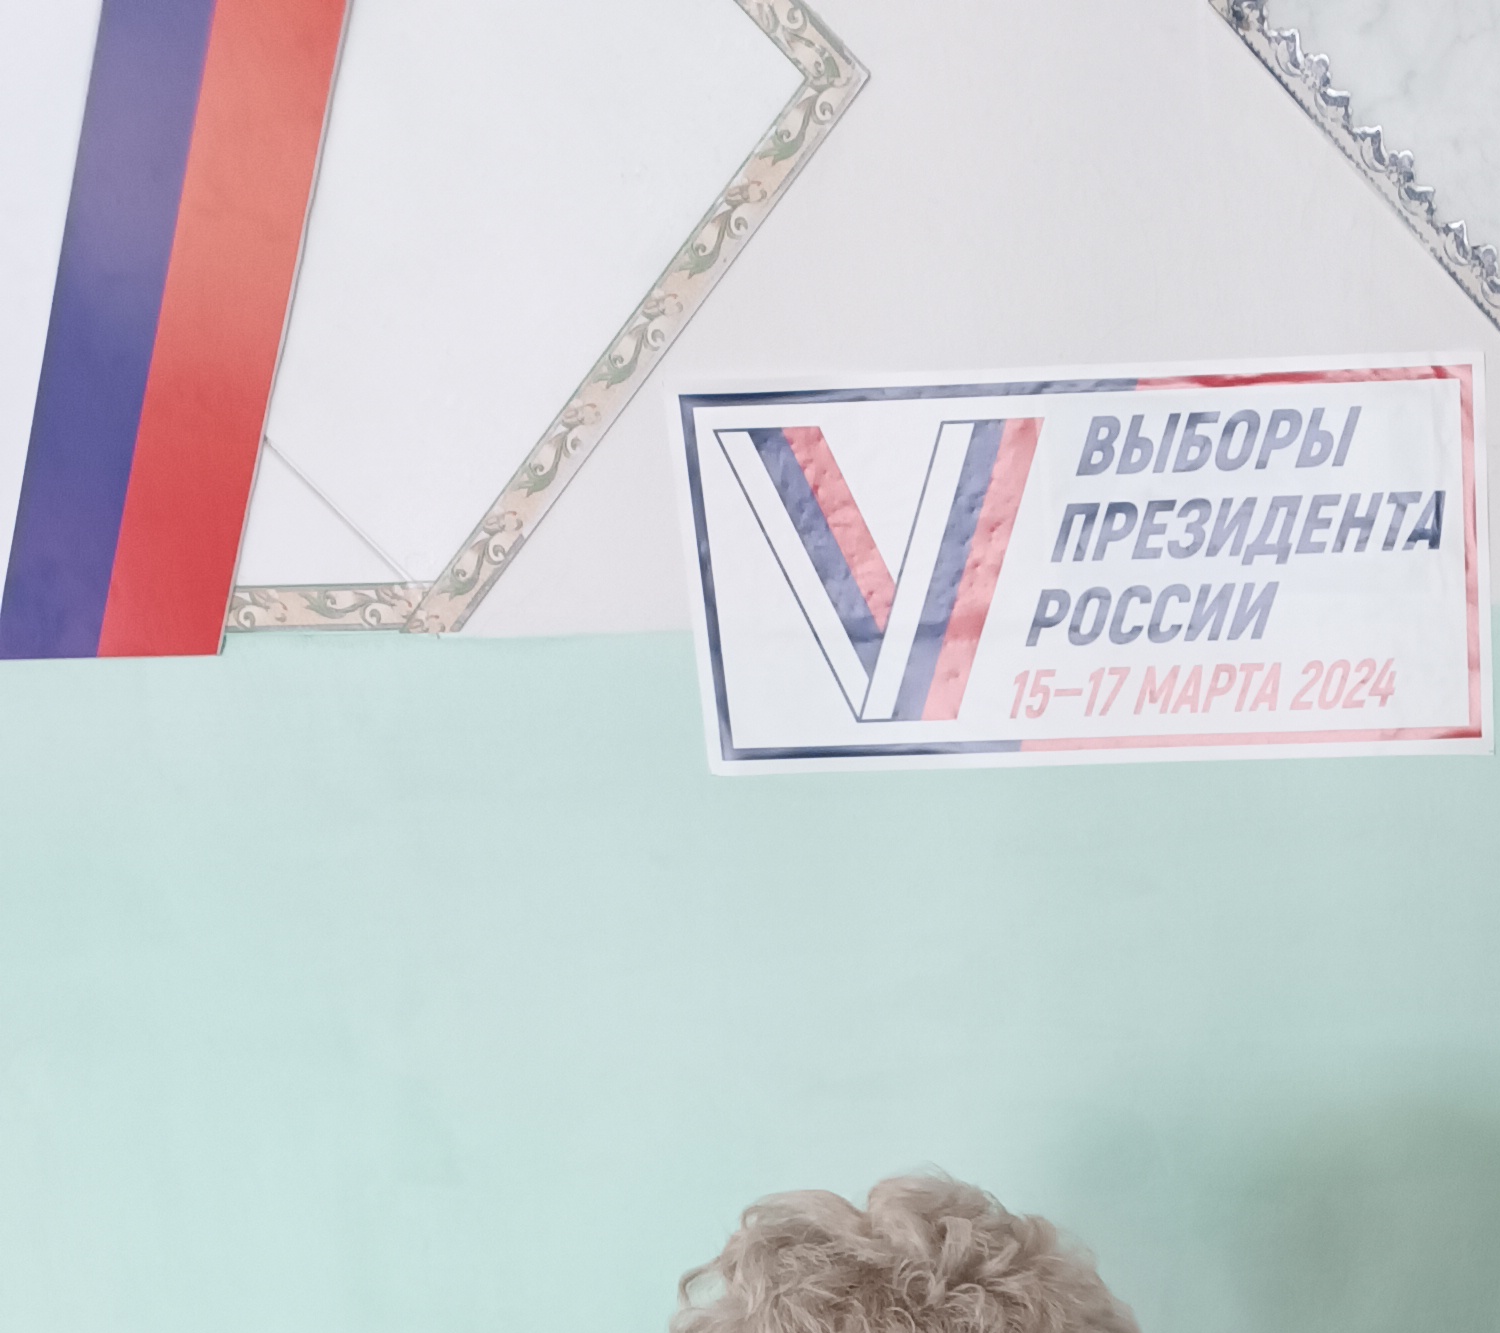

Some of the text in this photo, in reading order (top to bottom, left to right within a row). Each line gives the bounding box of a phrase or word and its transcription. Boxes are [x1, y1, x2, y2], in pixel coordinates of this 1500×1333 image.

[1075, 406, 1362, 477] ВЫБОРЫ
[1050, 490, 1447, 566] ПРЕЗИДЕНТА
[1025, 581, 1280, 647] РОССИИ
[1133, 662, 1282, 715] МАРТА
[1290, 657, 1397, 711] 2024
